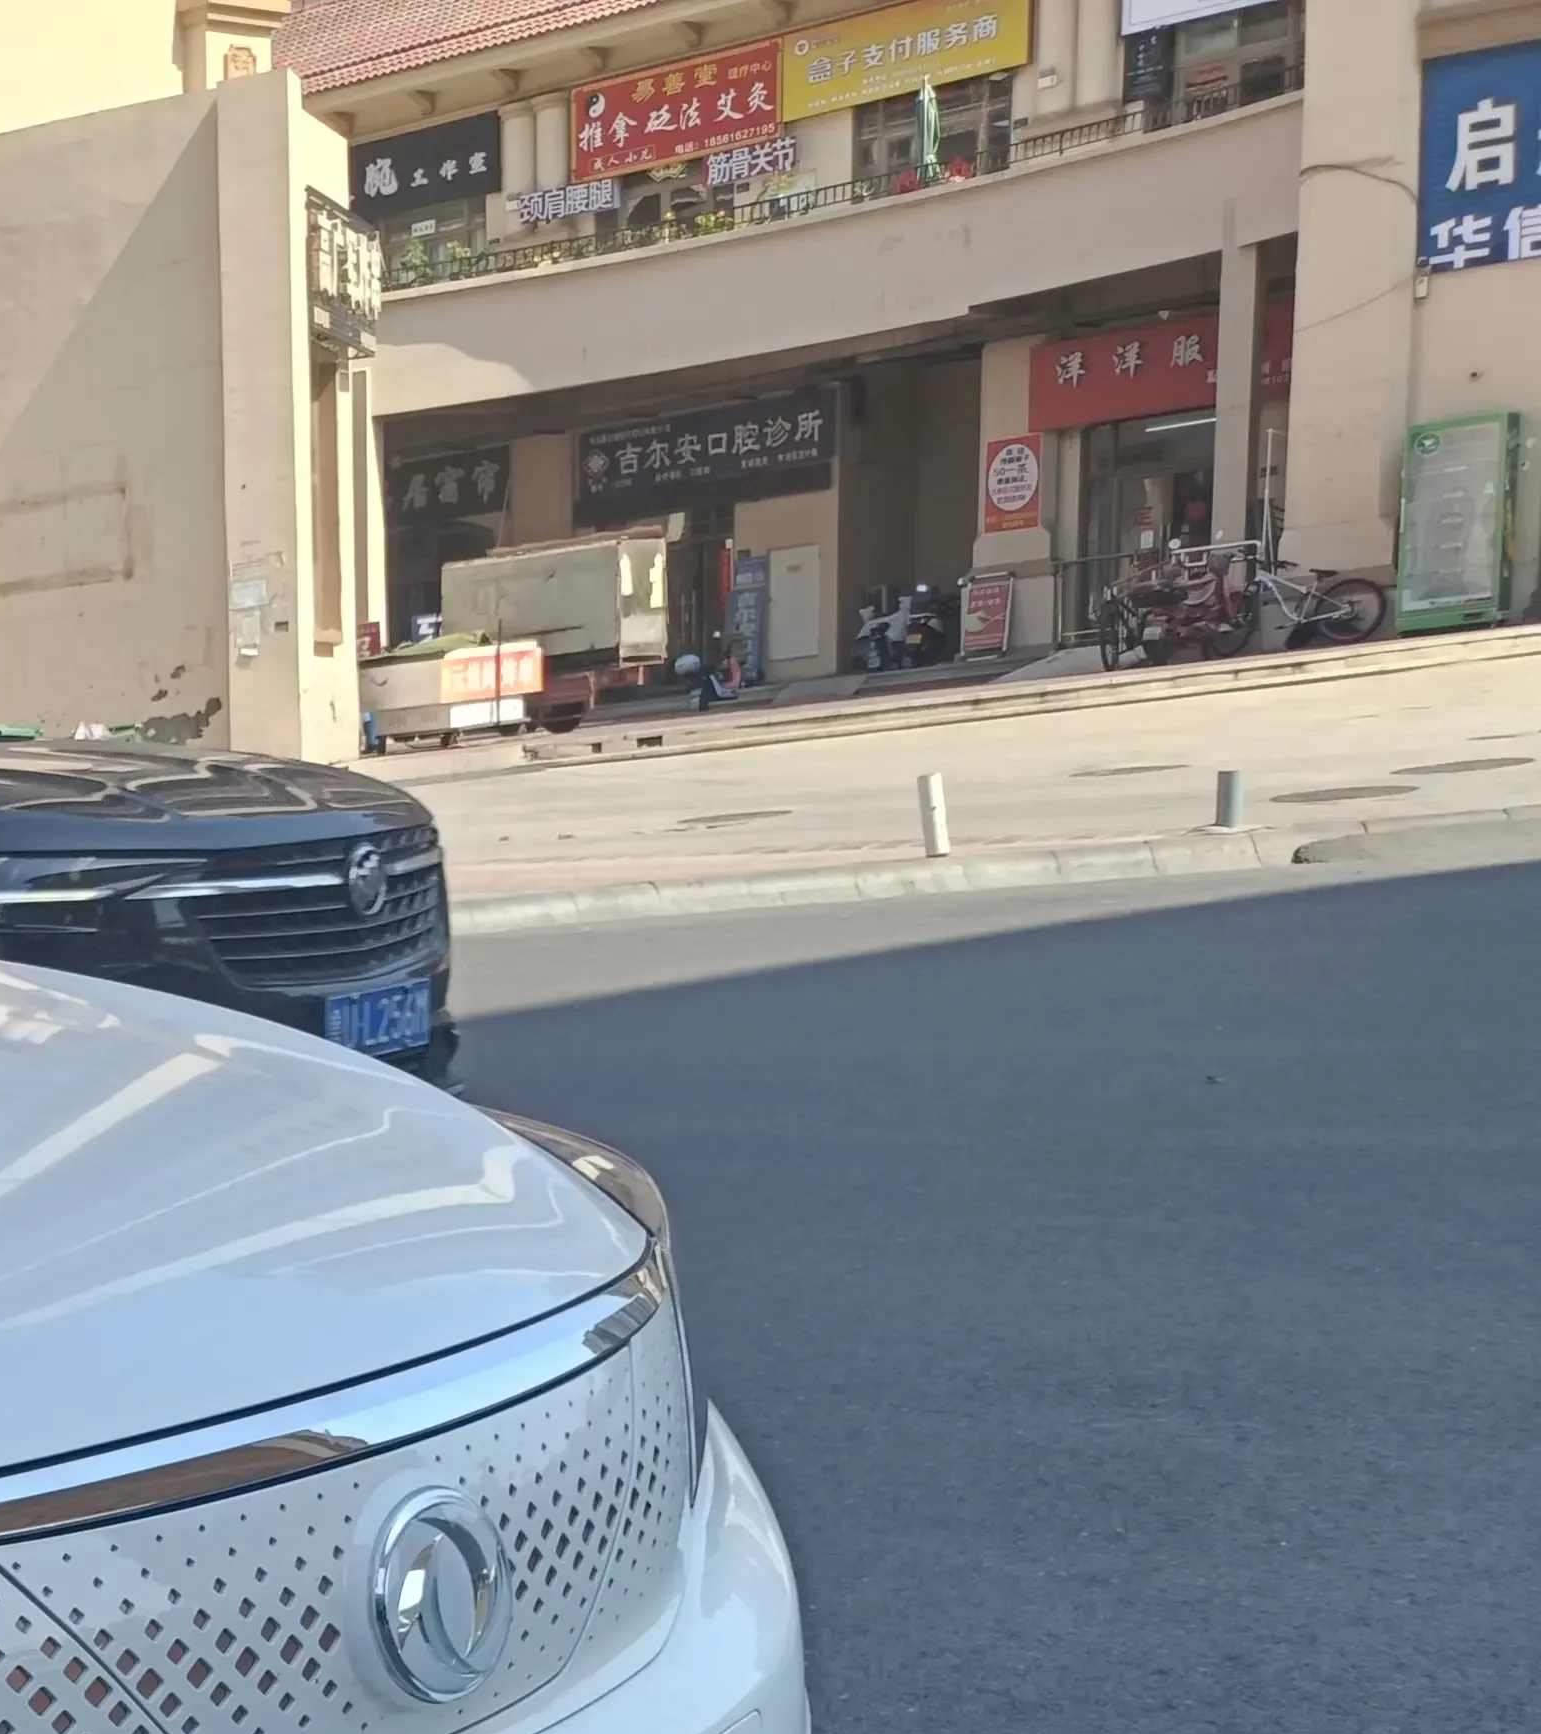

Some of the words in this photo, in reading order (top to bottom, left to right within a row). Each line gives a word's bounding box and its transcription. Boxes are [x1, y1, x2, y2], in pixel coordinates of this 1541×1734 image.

[808, 13, 998, 84] 盒子支付服务商
[578, 112, 638, 153] 推拿
[714, 81, 775, 122] 艾灸
[1445, 96, 1541, 192] 启
[705, 137, 796, 186] 筋骨关节
[520, 179, 613, 223] 颈肩腰腿
[615, 410, 824, 475] 吉尔安口腔诊所
